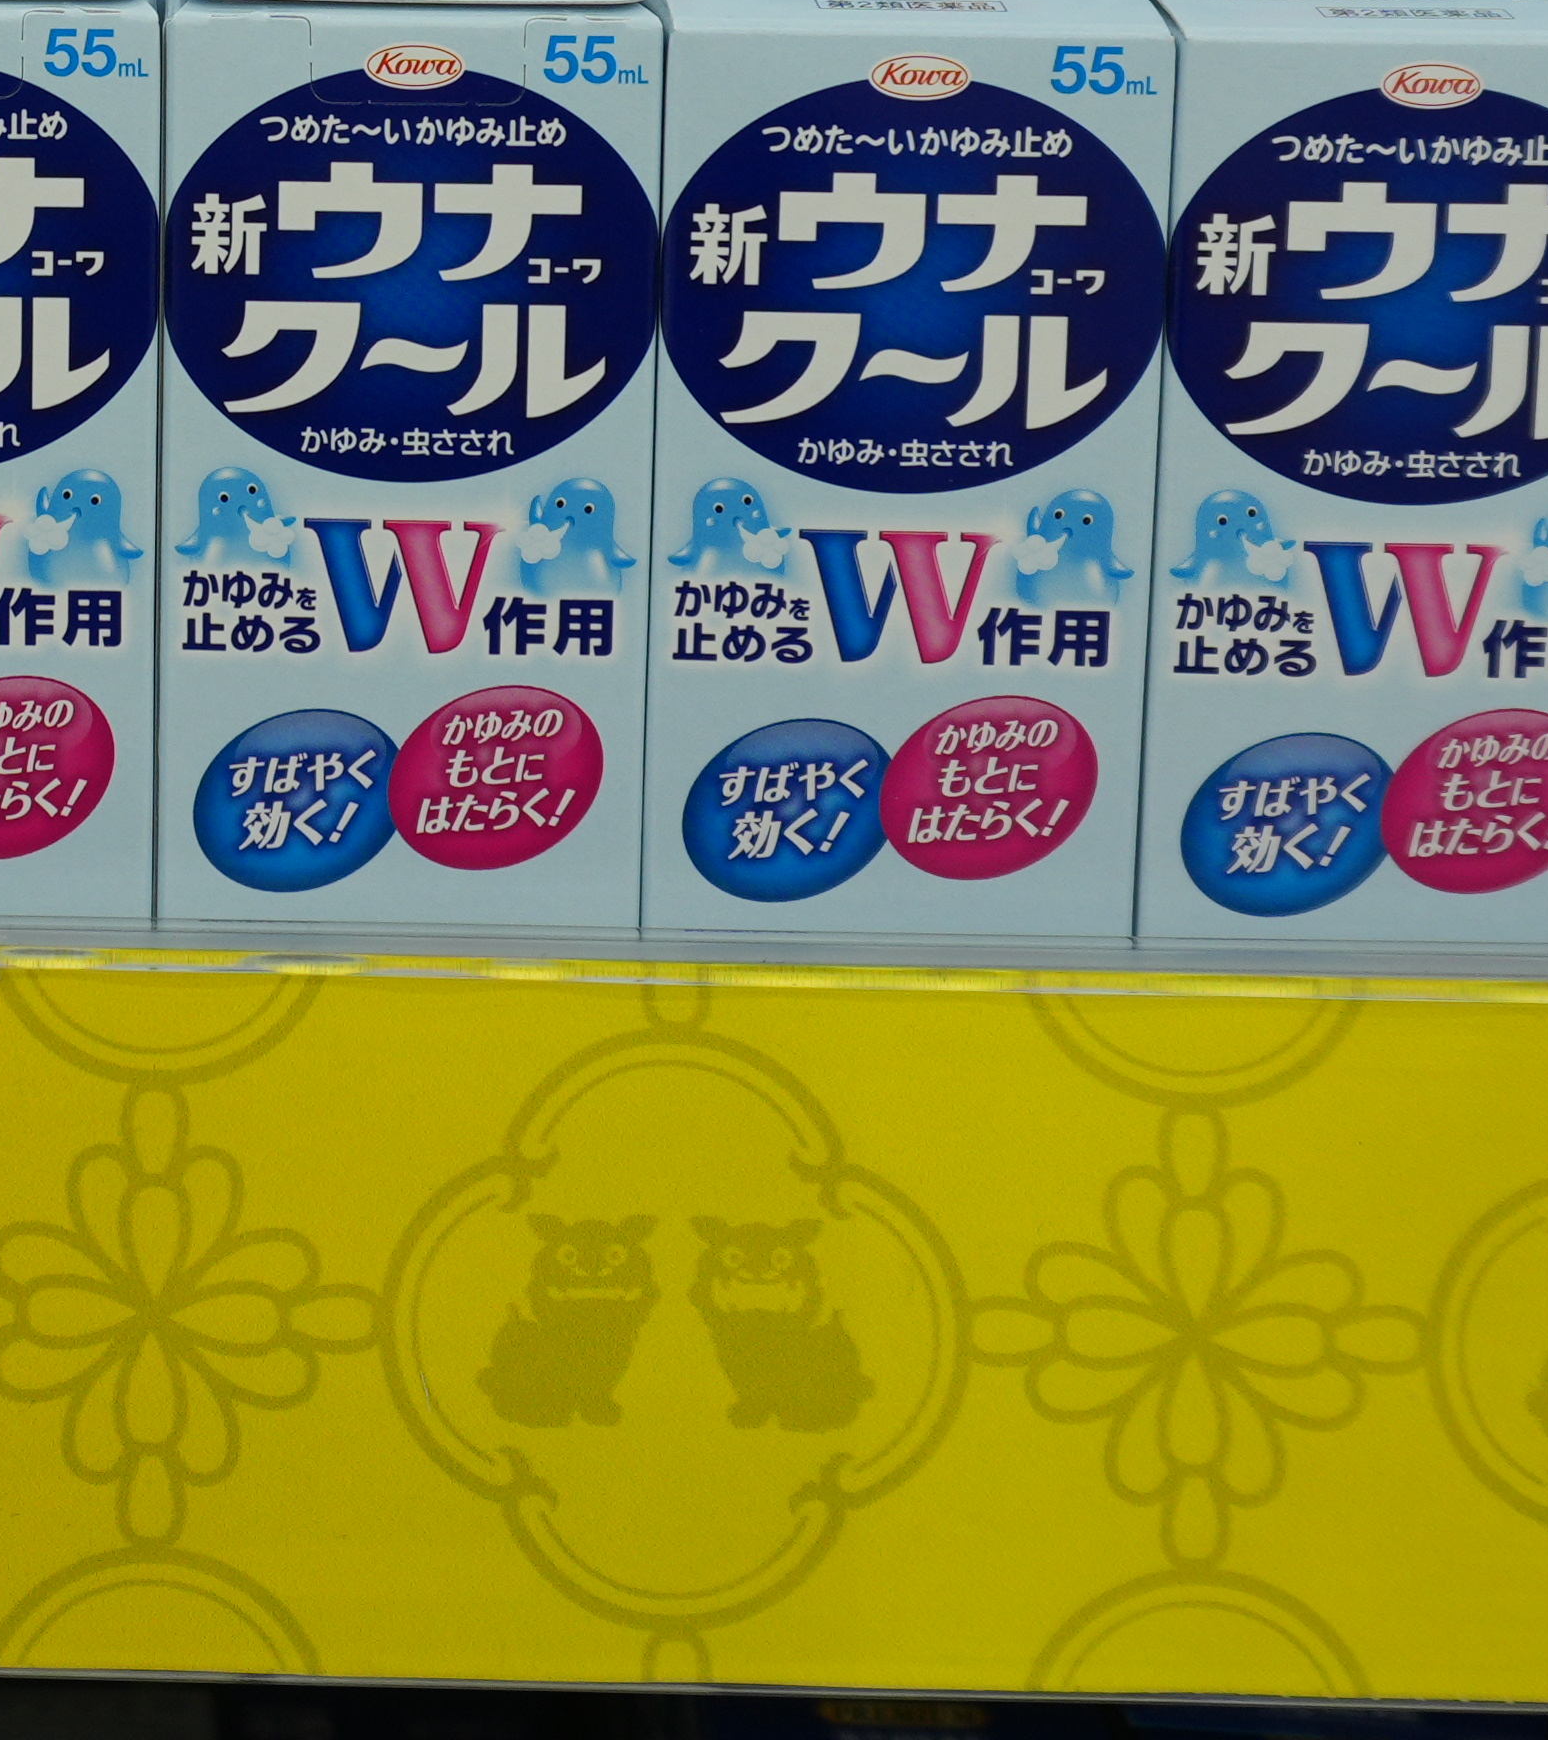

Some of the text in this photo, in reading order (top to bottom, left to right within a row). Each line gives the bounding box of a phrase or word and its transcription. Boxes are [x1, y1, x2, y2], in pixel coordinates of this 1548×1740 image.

[876, 58, 967, 88] Kowa
[1051, 48, 1159, 96] 55mL
[935, 718, 1057, 756] かゆみの
[719, 758, 870, 808] すばやく
[937, 756, 1038, 797] もとに
